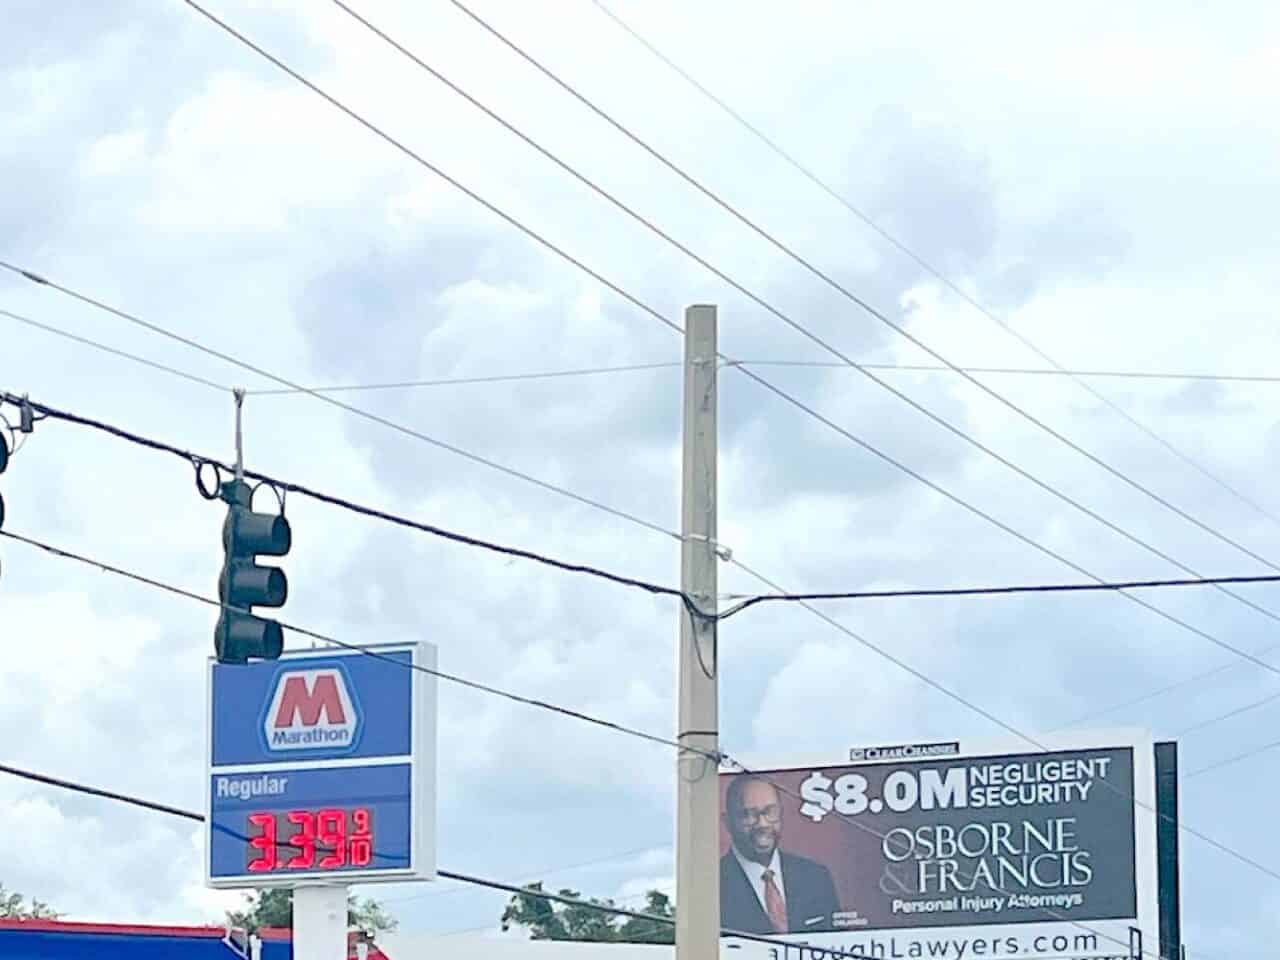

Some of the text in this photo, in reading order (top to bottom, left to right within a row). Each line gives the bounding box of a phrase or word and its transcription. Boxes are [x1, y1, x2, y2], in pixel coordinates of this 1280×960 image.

[272, 728, 350, 745] Marathon
[969, 757, 1112, 787] NEGLIGENT
[217, 774, 289, 800] Regular
[799, 766, 968, 822] $8.0M
[970, 780, 1094, 809] SECURITY
[882, 817, 1080, 862] OSBORNE
[917, 850, 1093, 894] FRANCIS
[892, 892, 1084, 914] Personal Injury Attorneys
